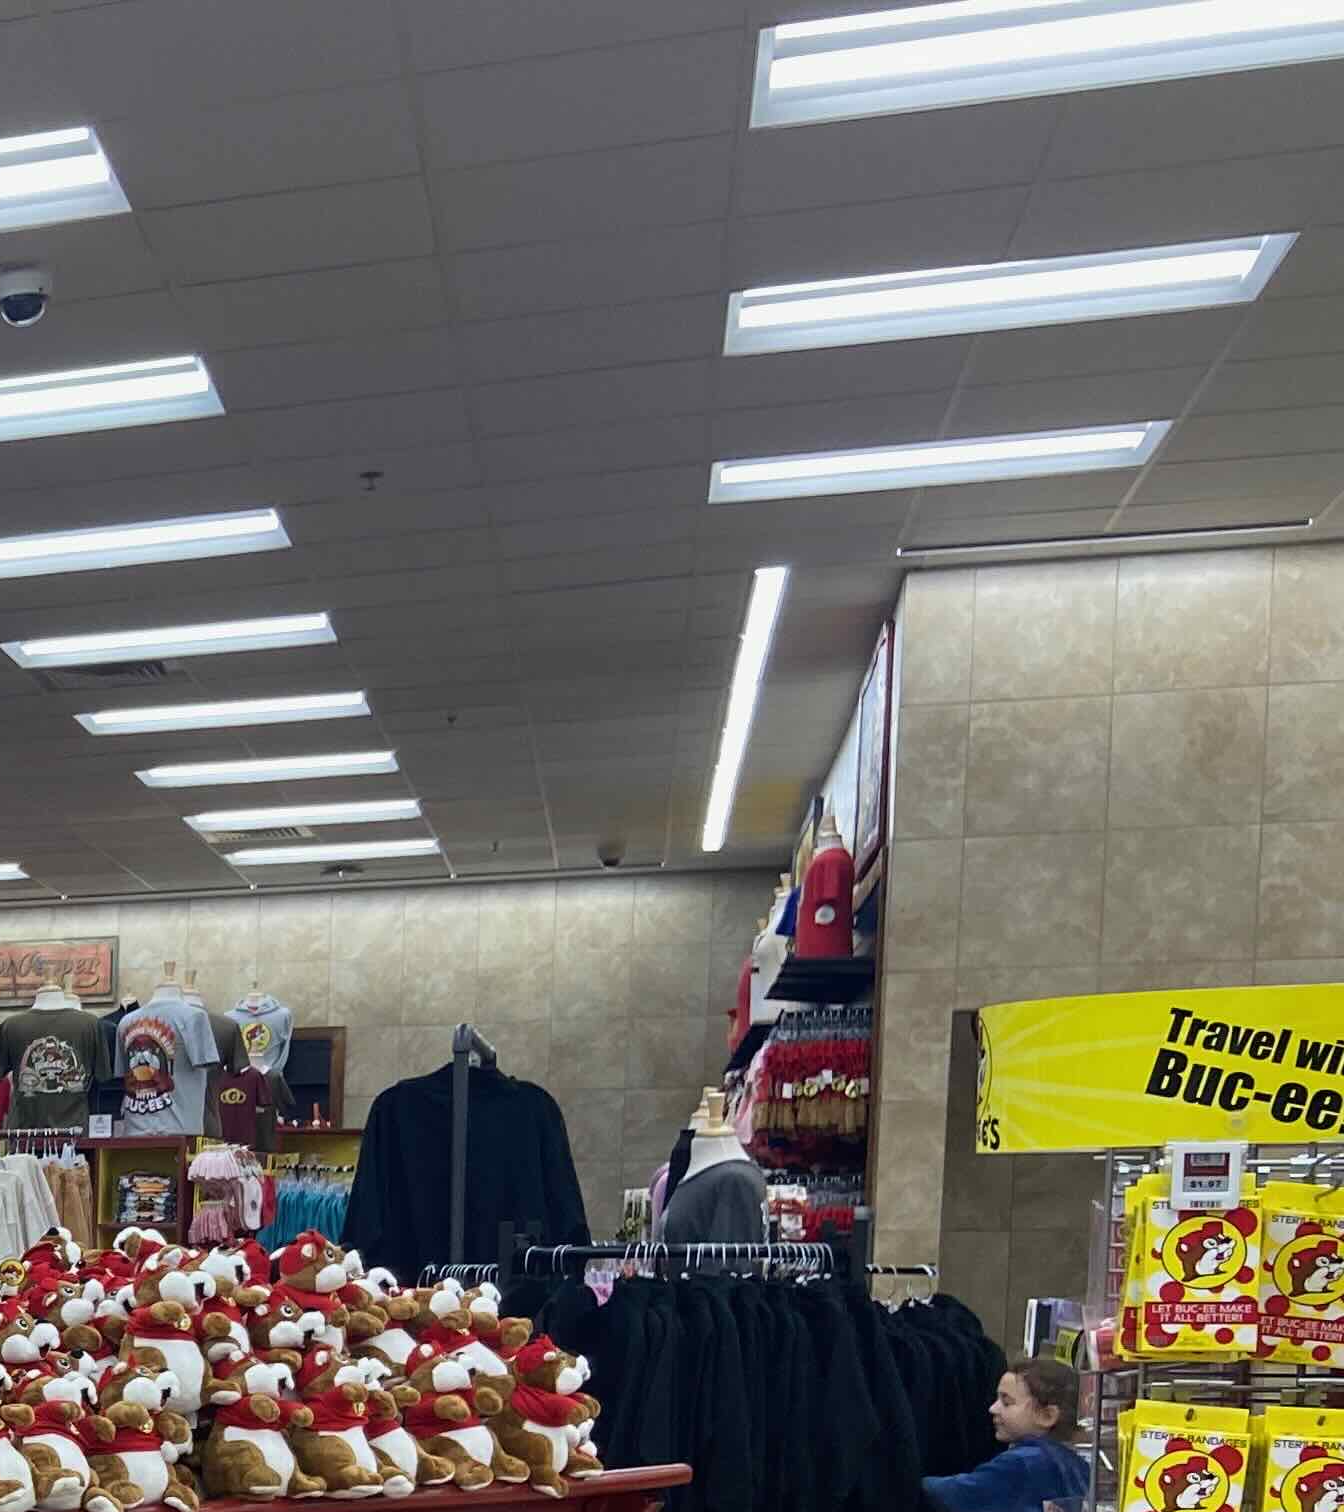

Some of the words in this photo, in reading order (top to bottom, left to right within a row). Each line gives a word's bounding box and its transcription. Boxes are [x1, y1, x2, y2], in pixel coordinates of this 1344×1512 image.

[1169, 1007, 1293, 1064] Travel
[1295, 1039, 1344, 1076] wi
[1152, 1304, 1171, 1313] LET
